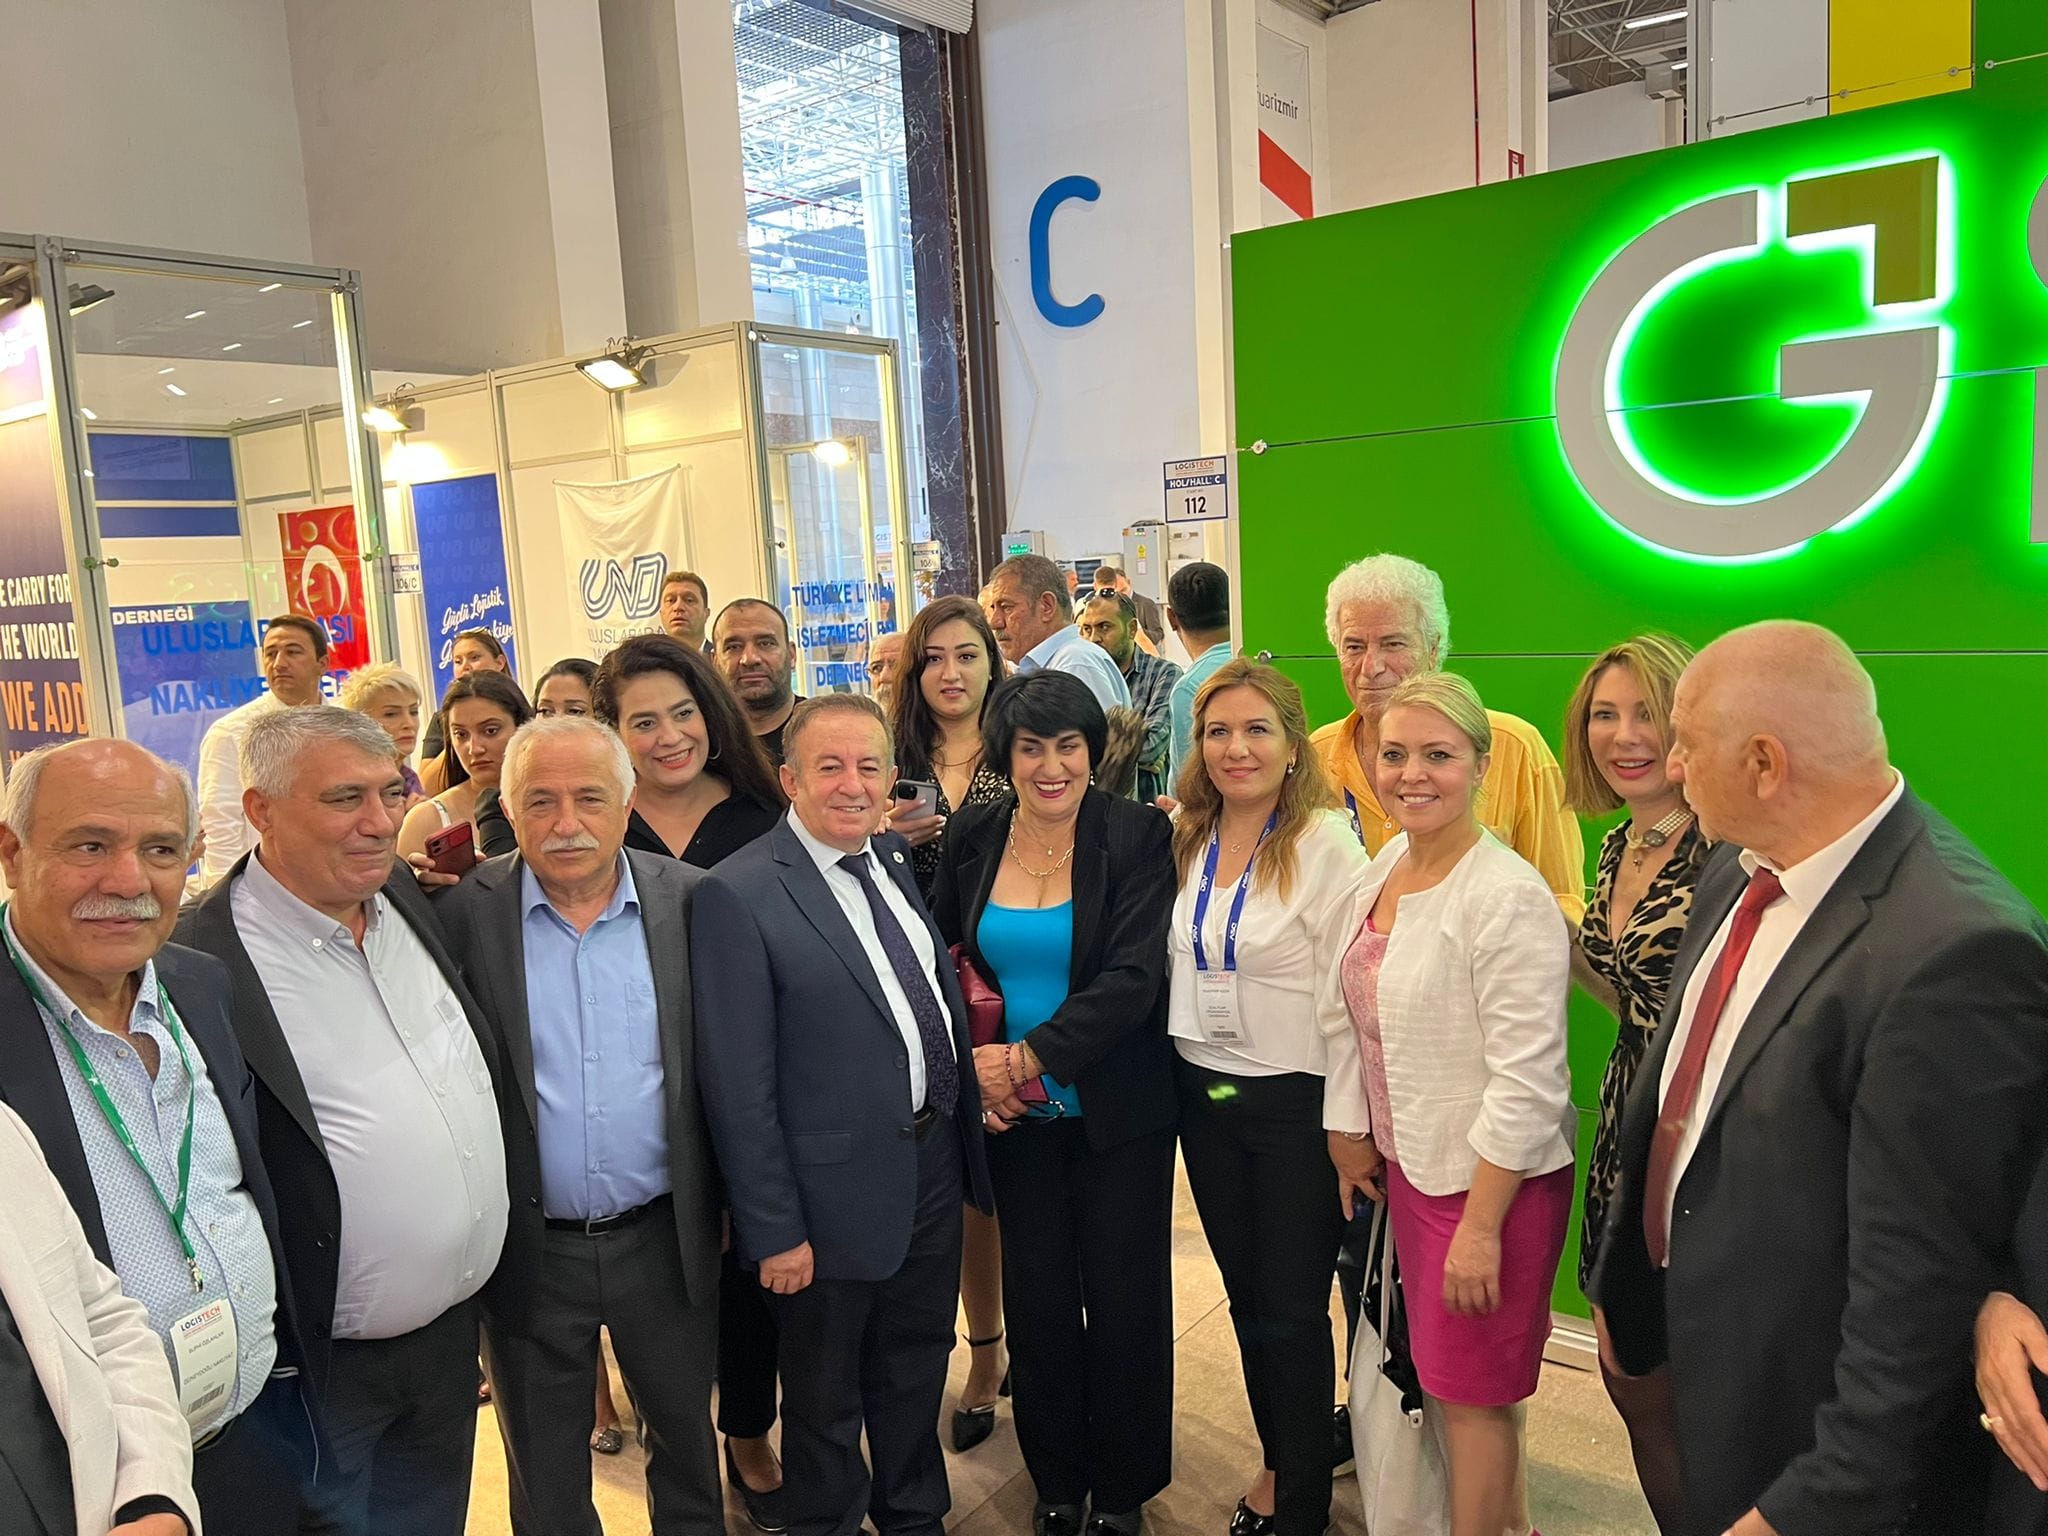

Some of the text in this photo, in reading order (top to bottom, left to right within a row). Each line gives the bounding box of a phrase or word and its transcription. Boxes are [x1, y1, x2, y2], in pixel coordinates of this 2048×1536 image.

[1257, 91, 1298, 120] uarizmir
[1030, 175, 1105, 328] C
[1175, 460, 1215, 471] LOGISTECH
[1184, 496, 1207, 514] 112
[7, 575, 46, 607] CARRY
[48, 573, 72, 605] FOR
[112, 605, 194, 626] DERNEĞİ
[0, 622, 79, 660] HE WORLD
[0, 680, 88, 734] WE ADD
[180, 1305, 221, 1332] LOGISTECH
